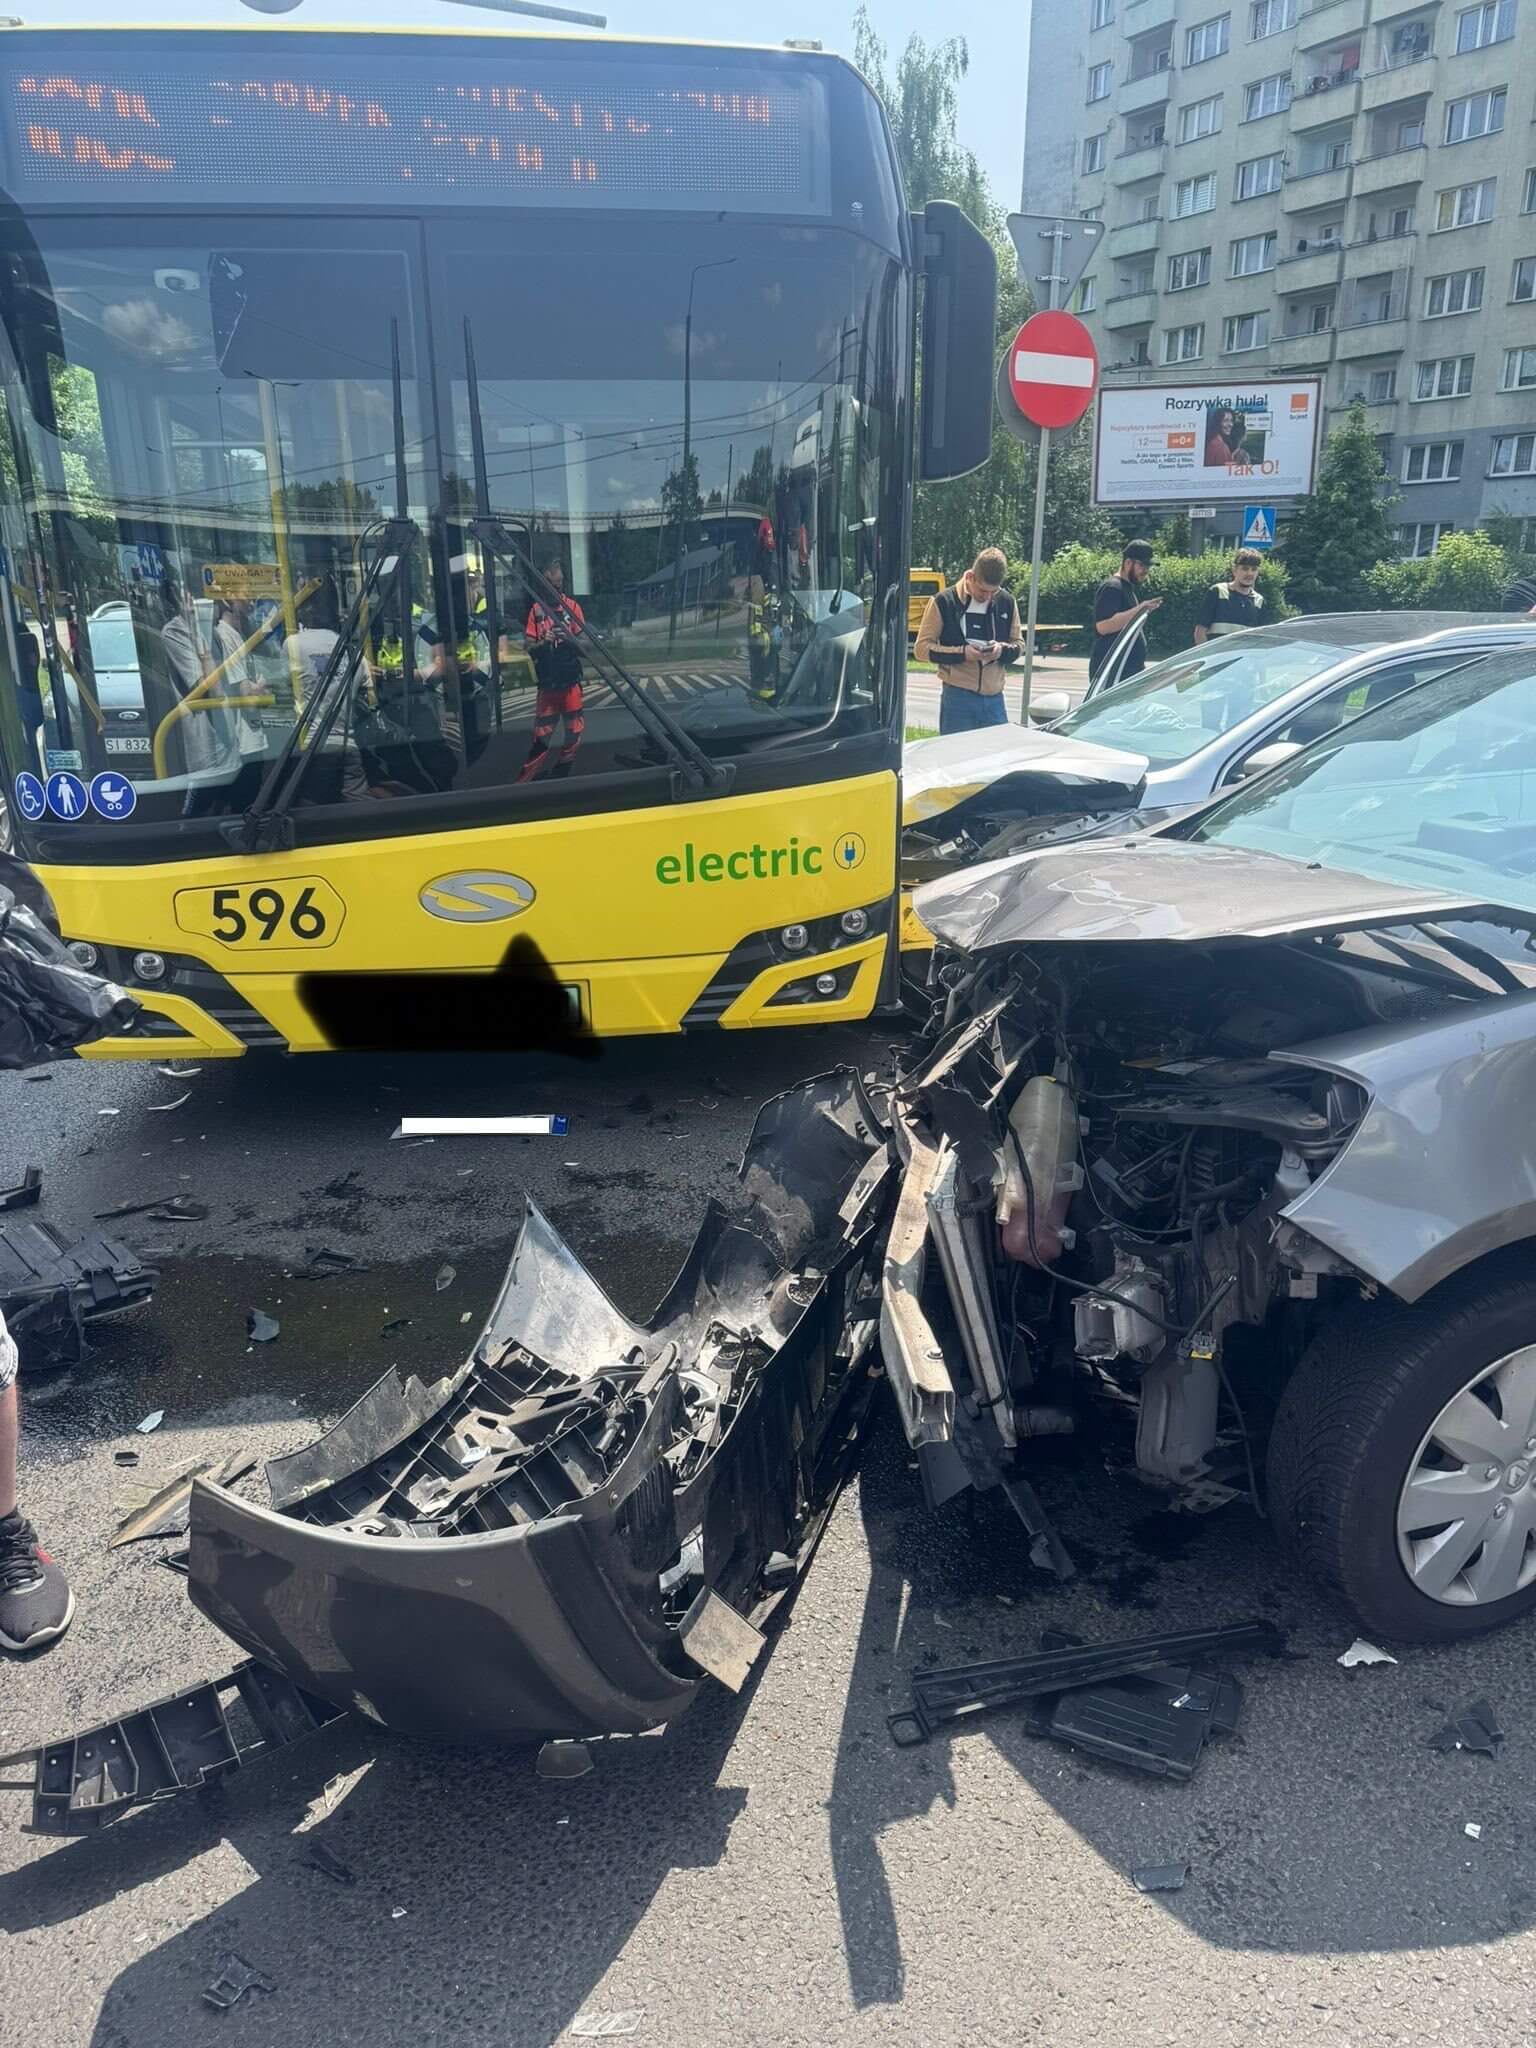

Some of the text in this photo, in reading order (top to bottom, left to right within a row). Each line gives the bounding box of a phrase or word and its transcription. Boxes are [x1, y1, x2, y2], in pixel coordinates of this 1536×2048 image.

[1165, 393, 1268, 411] Rozrywka hula!
[1225, 461, 1254, 476] Tak
[655, 837, 822, 885] electric
[212, 887, 326, 942] 596
